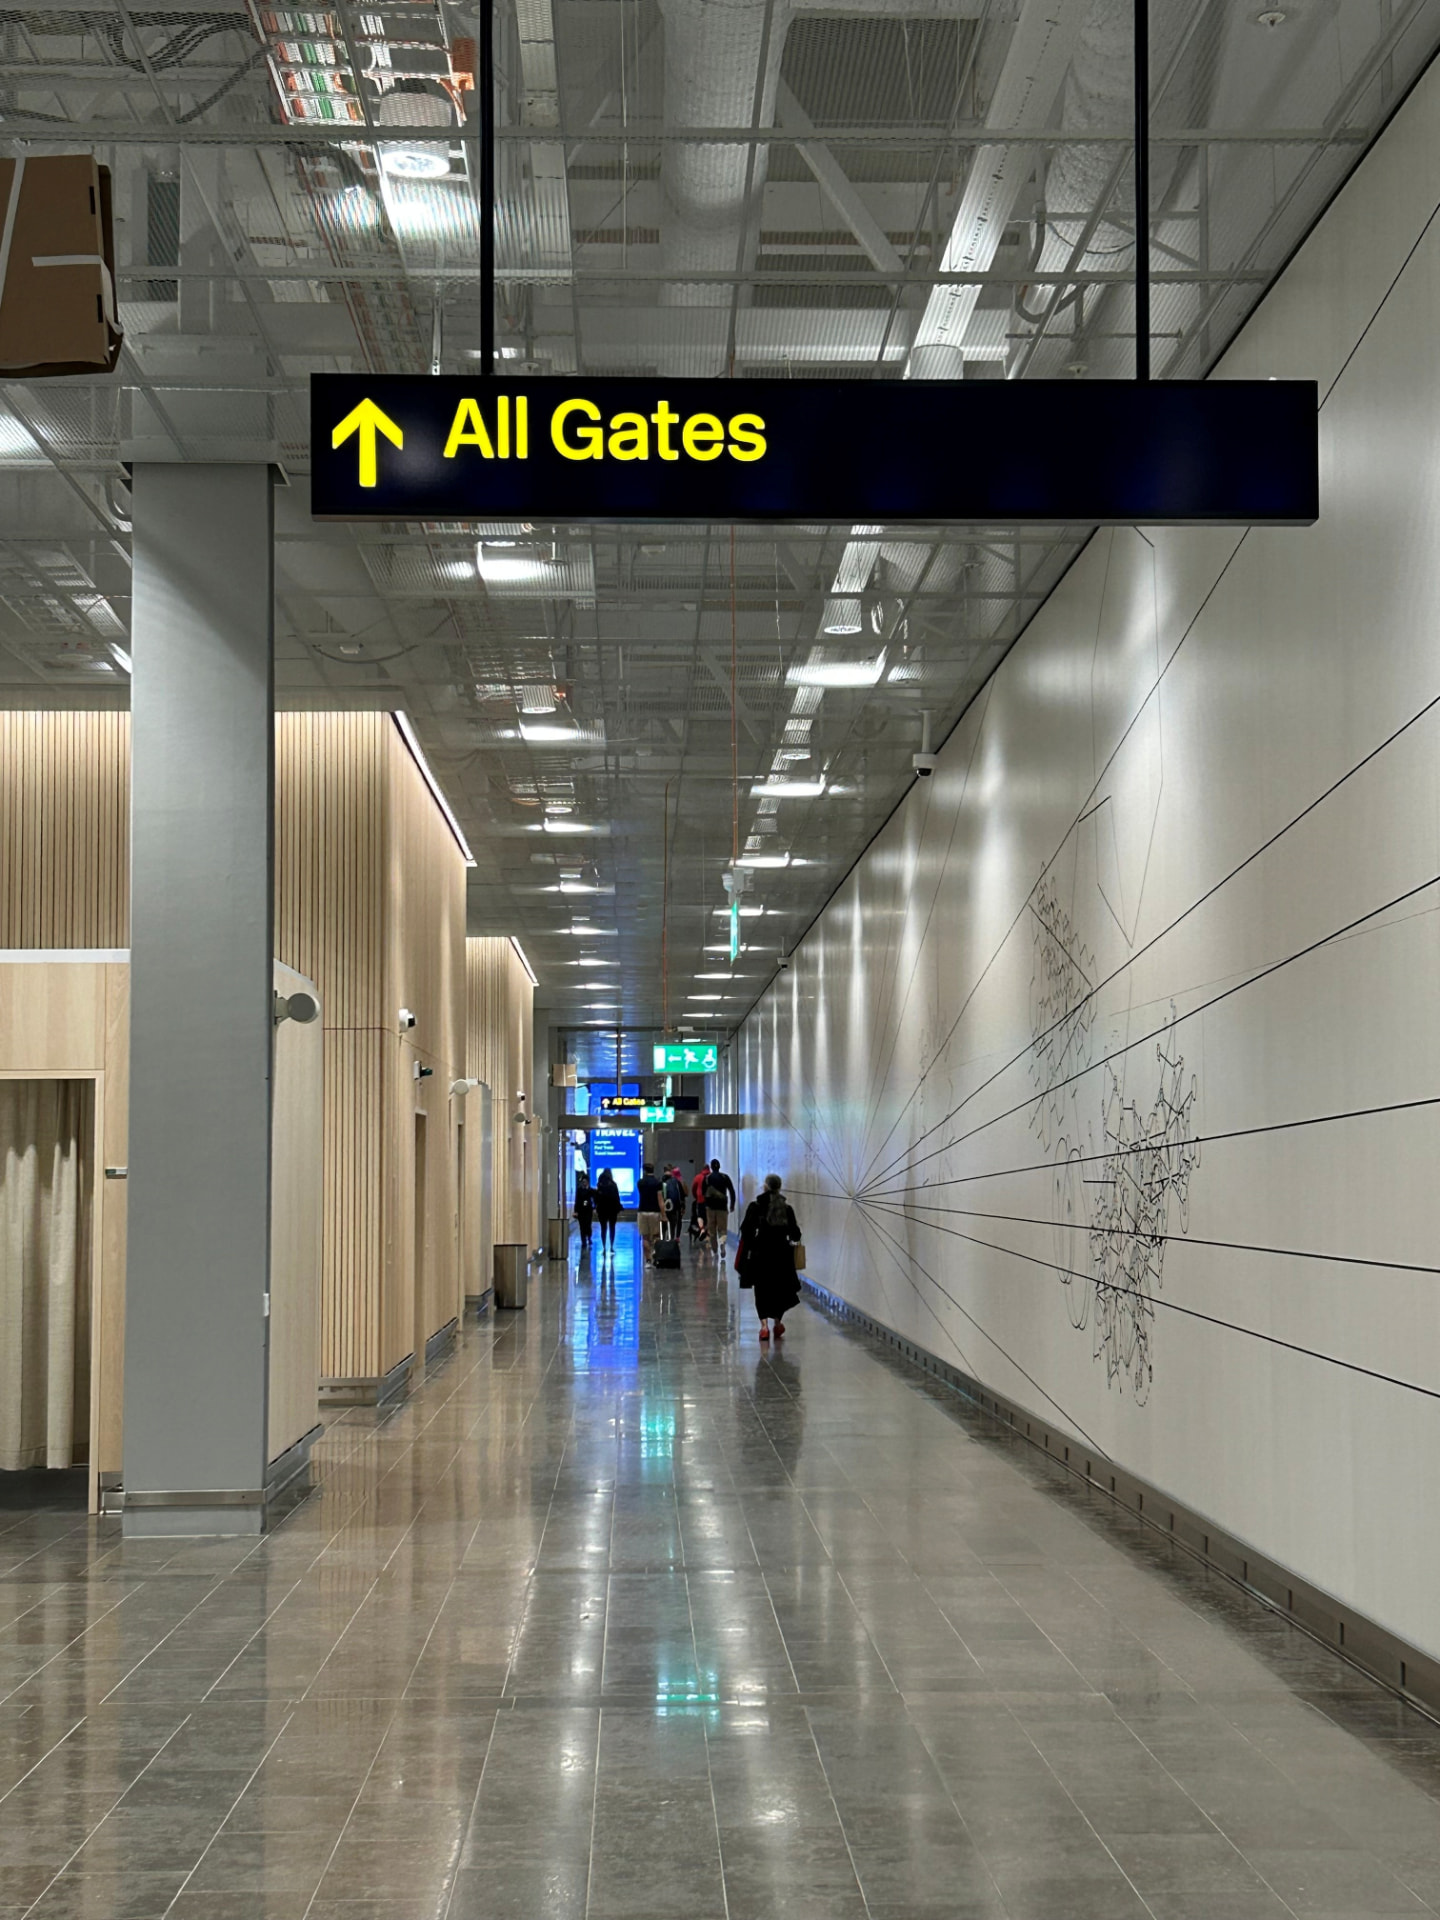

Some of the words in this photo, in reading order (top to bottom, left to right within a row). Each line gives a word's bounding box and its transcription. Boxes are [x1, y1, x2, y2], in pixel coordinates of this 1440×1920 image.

[443, 395, 528, 459] All
[550, 398, 767, 462] Gates
[612, 1097, 622, 1106] All
[623, 1097, 646, 1106] Gates
[595, 1129, 636, 1137] TRAVEL
